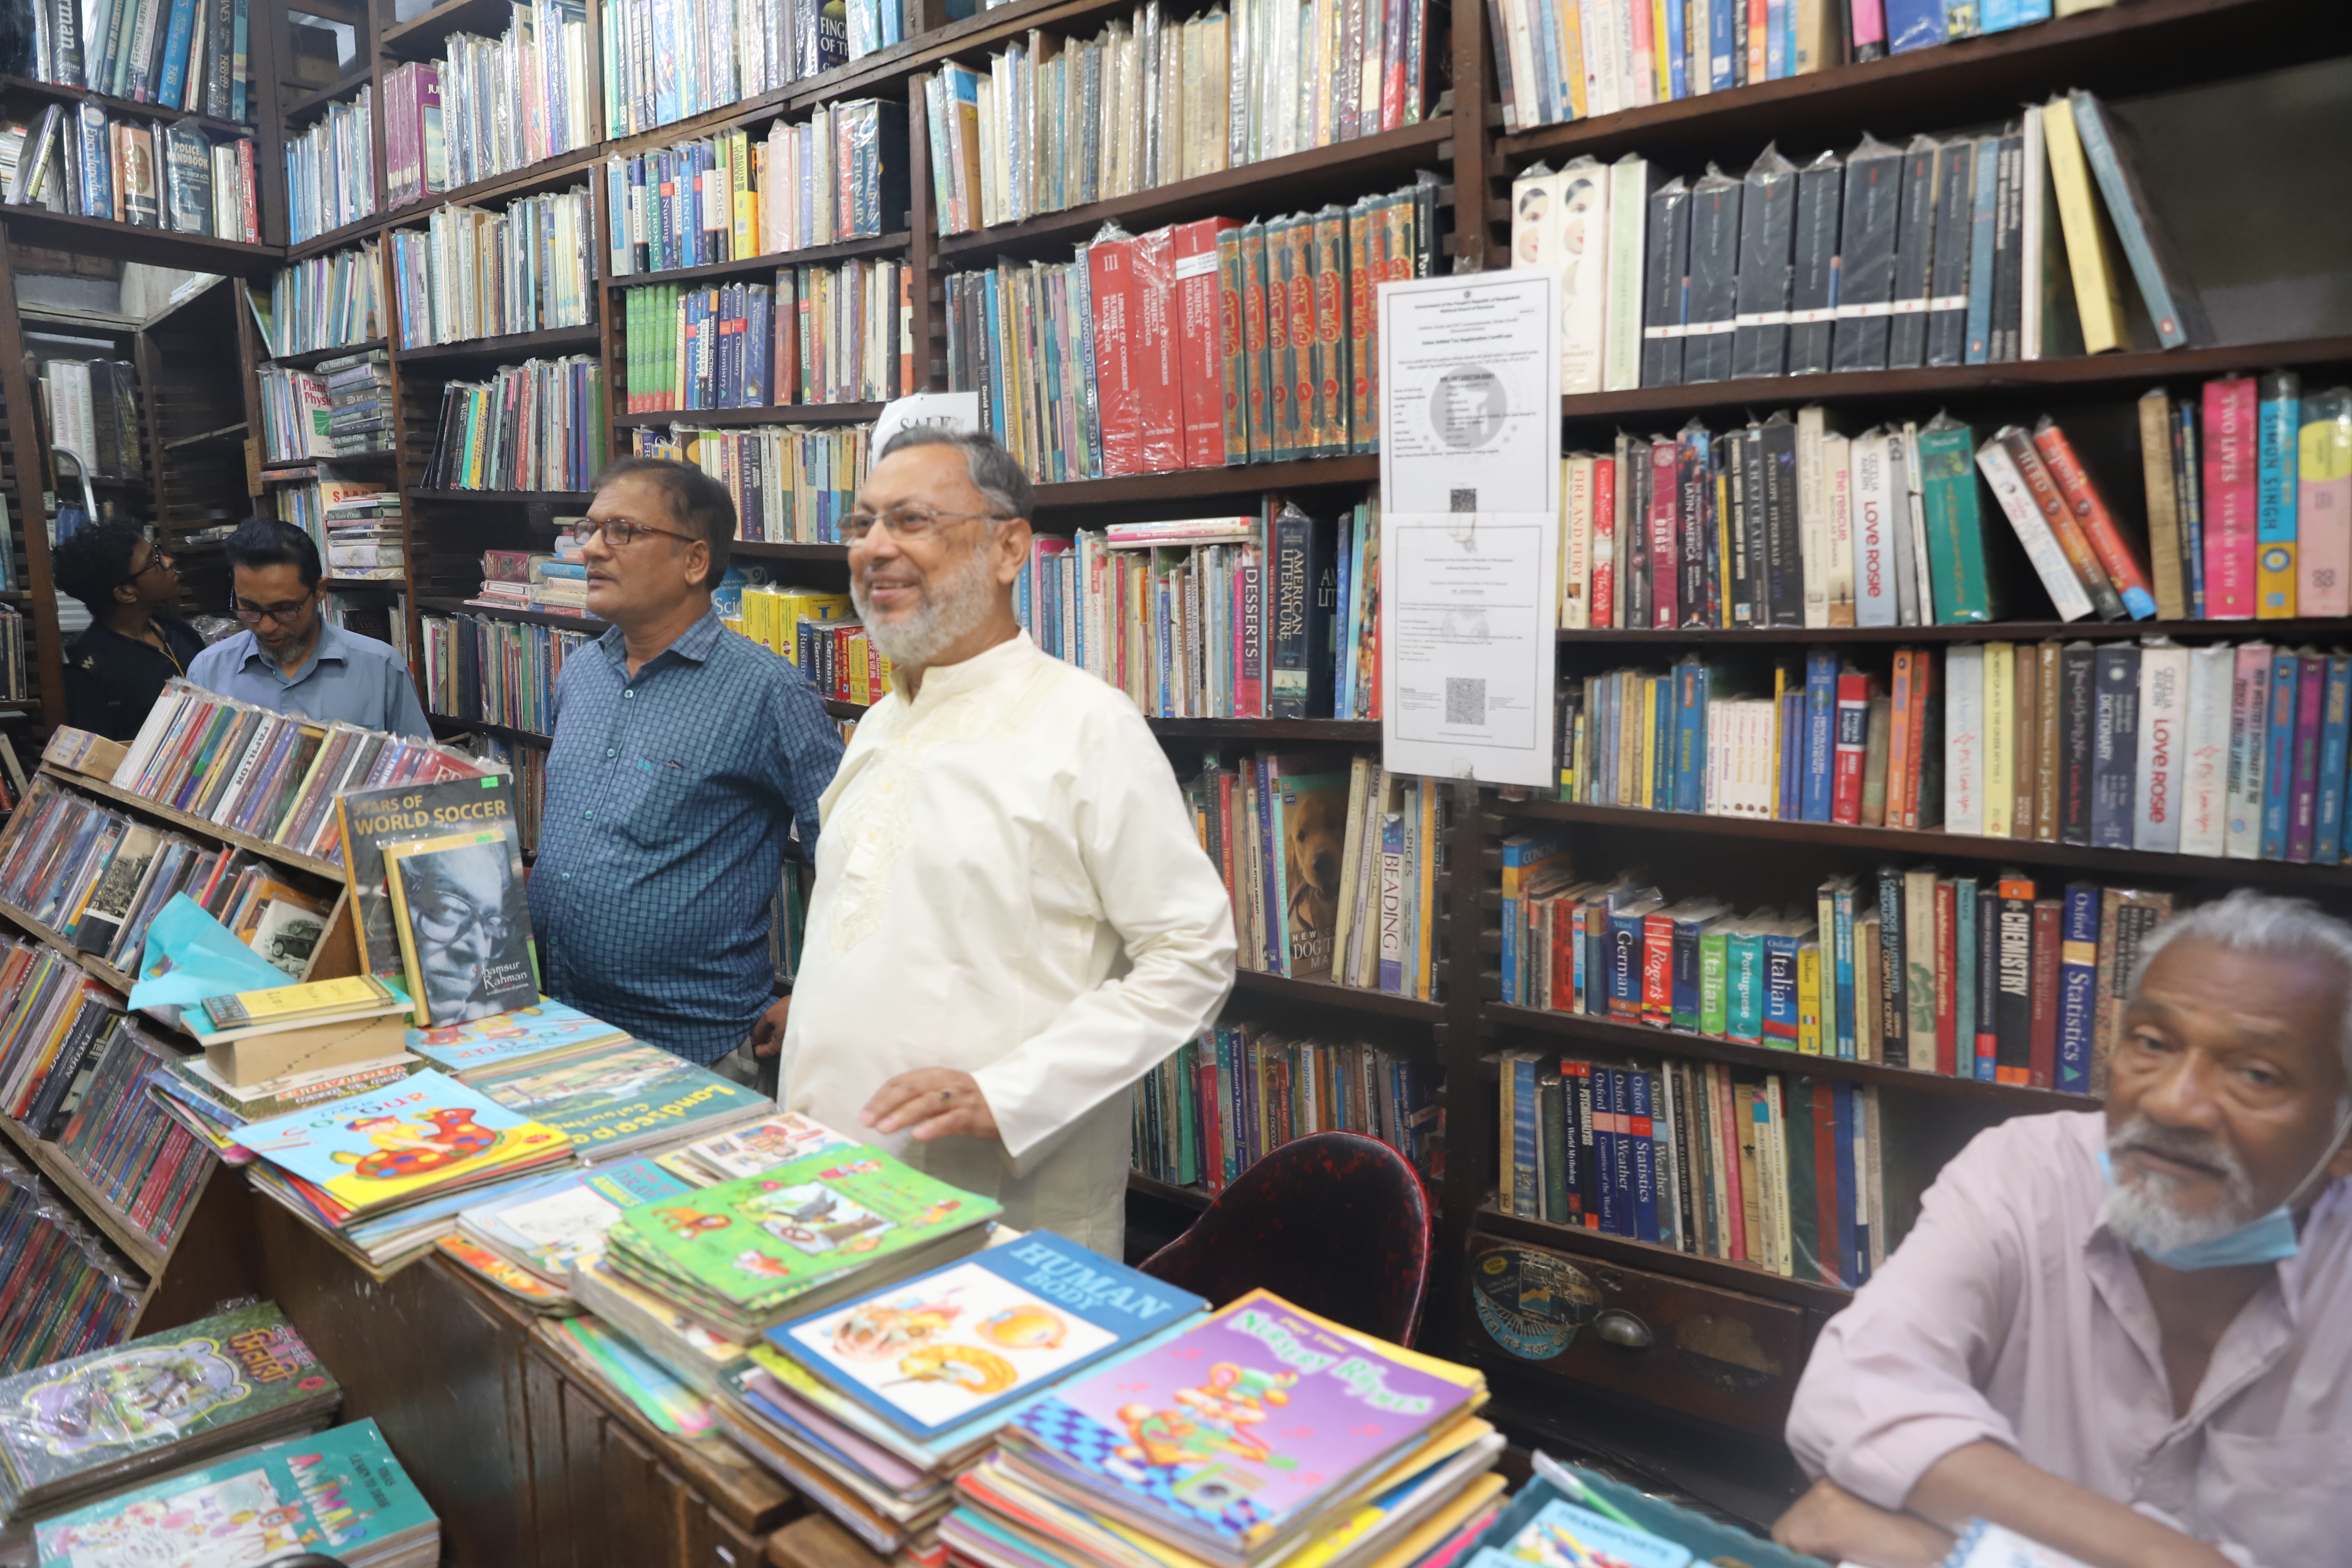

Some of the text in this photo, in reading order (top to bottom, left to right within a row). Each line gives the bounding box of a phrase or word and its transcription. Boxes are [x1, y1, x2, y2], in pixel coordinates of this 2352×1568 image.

[166, 65, 179, 84] 1988
[219, 54, 230, 88] 1988-89
[84, 127, 99, 196] Encyclopedia
[167, 152, 208, 170] HANDBOOK
[175, 142, 200, 156] POLICE
[651, 183, 659, 262] ELECTRONICS
[662, 198, 671, 243] Nursing
[1104, 254, 1118, 271] III
[1102, 296, 1112, 352] HEADINGS
[1110, 295, 1119, 341] SUBJECT
[1143, 288, 1152, 346] HEADINGS
[1150, 287, 1159, 334] SUBJECT
[1185, 279, 1195, 338] HEADINGS
[1194, 277, 1203, 326] SUBJECT
[1204, 317, 1211, 329] OF
[978, 317, 987, 361] Knowledge
[1076, 254, 1098, 456] GUINNESS WORLD RECORDS 2012
[1119, 331, 1125, 344] OF
[1204, 331, 1213, 379] CONGRESS
[303, 379, 326, 393] Plant
[1120, 346, 1129, 392] CONGRESS
[981, 385, 989, 409] David
[2221, 395, 2237, 482] TWO LIVES
[743, 452, 751, 490] LEHANE
[1574, 469, 1583, 504] FIRE
[1869, 453, 1878, 492] CECELIA
[2018, 452, 2047, 492] HERO
[2263, 415, 2278, 530] SIMON SINGH
[1684, 482, 1696, 562] LATIN AMERICA
[1749, 458, 1762, 561] KHAJURAHO
[1835, 470, 1847, 541] the rescue
[1573, 539, 1583, 579] FURY
[2224, 493, 2237, 587] VIKRAM SETH
[554, 567, 570, 576] Majorelle
[1294, 548, 1304, 637] AMERICAN
[544, 605, 565, 614] ANIMALS
[1244, 568, 1259, 658] DESSERTS
[1281, 548, 1292, 642] LITERATURE
[1185, 621, 1193, 632] OF
[799, 633, 808, 677] Russian
[868, 642, 876, 679] 汉英词典
[2153, 670, 2163, 707] AHERN
[2162, 667, 2174, 709] CECELIA
[2098, 694, 2112, 761] DICTIONARY
[235, 725, 270, 786] PAPILLON
[1682, 729, 1692, 772] Korean
[352, 795, 423, 816] STARS OF
[354, 800, 507, 836] WORLD SOCCER
[1405, 827, 1414, 877] SPICES
[1382, 854, 1401, 950] BEADING
[1292, 930, 1317, 942] NEW
[1293, 942, 1322, 960] DOG
[1767, 940, 1796, 949] Oxford
[1938, 890, 1950, 1016] Amphibians and Reptiles
[2000, 912, 2030, 997] CHEMISTRY
[472, 961, 521, 975] Shamsur
[483, 971, 528, 990] Rahman
[1617, 930, 1633, 997] German
[1645, 946, 1667, 1000] Roget's
[1704, 950, 1722, 1014] Italian
[1739, 951, 1753, 1019] Portuguese
[1770, 950, 1793, 1017] Italian
[2063, 893, 2089, 1062] Oxford Statistics
[491, 986, 511, 995] collection
[48, 1002, 89, 1073] INSURGENT
[65, 1033, 94, 1078] TYCOON
[276, 1065, 407, 1101] VEGETABLES
[1303, 1050, 1312, 1101] Pregnancy
[1400, 1069, 1410, 1109] 30-minute
[1594, 1072, 1606, 1110] Oxford
[573, 1084, 736, 1146] Landscape
[1579, 1088, 1592, 1146] PSYCHOANALYSIS
[1615, 1074, 1629, 1191] Oxford Weather
[1404, 1129, 1412, 1152] cakes
[1600, 1137, 1608, 1171] Countries
[1633, 1076, 1651, 1203] Oxford Statistics
[1651, 1081, 1667, 1198] Oxford Weather
[1602, 1173, 1609, 1182] of
[1009, 1240, 1174, 1321] HUMAN
[1021, 1270, 1104, 1312] BODY
